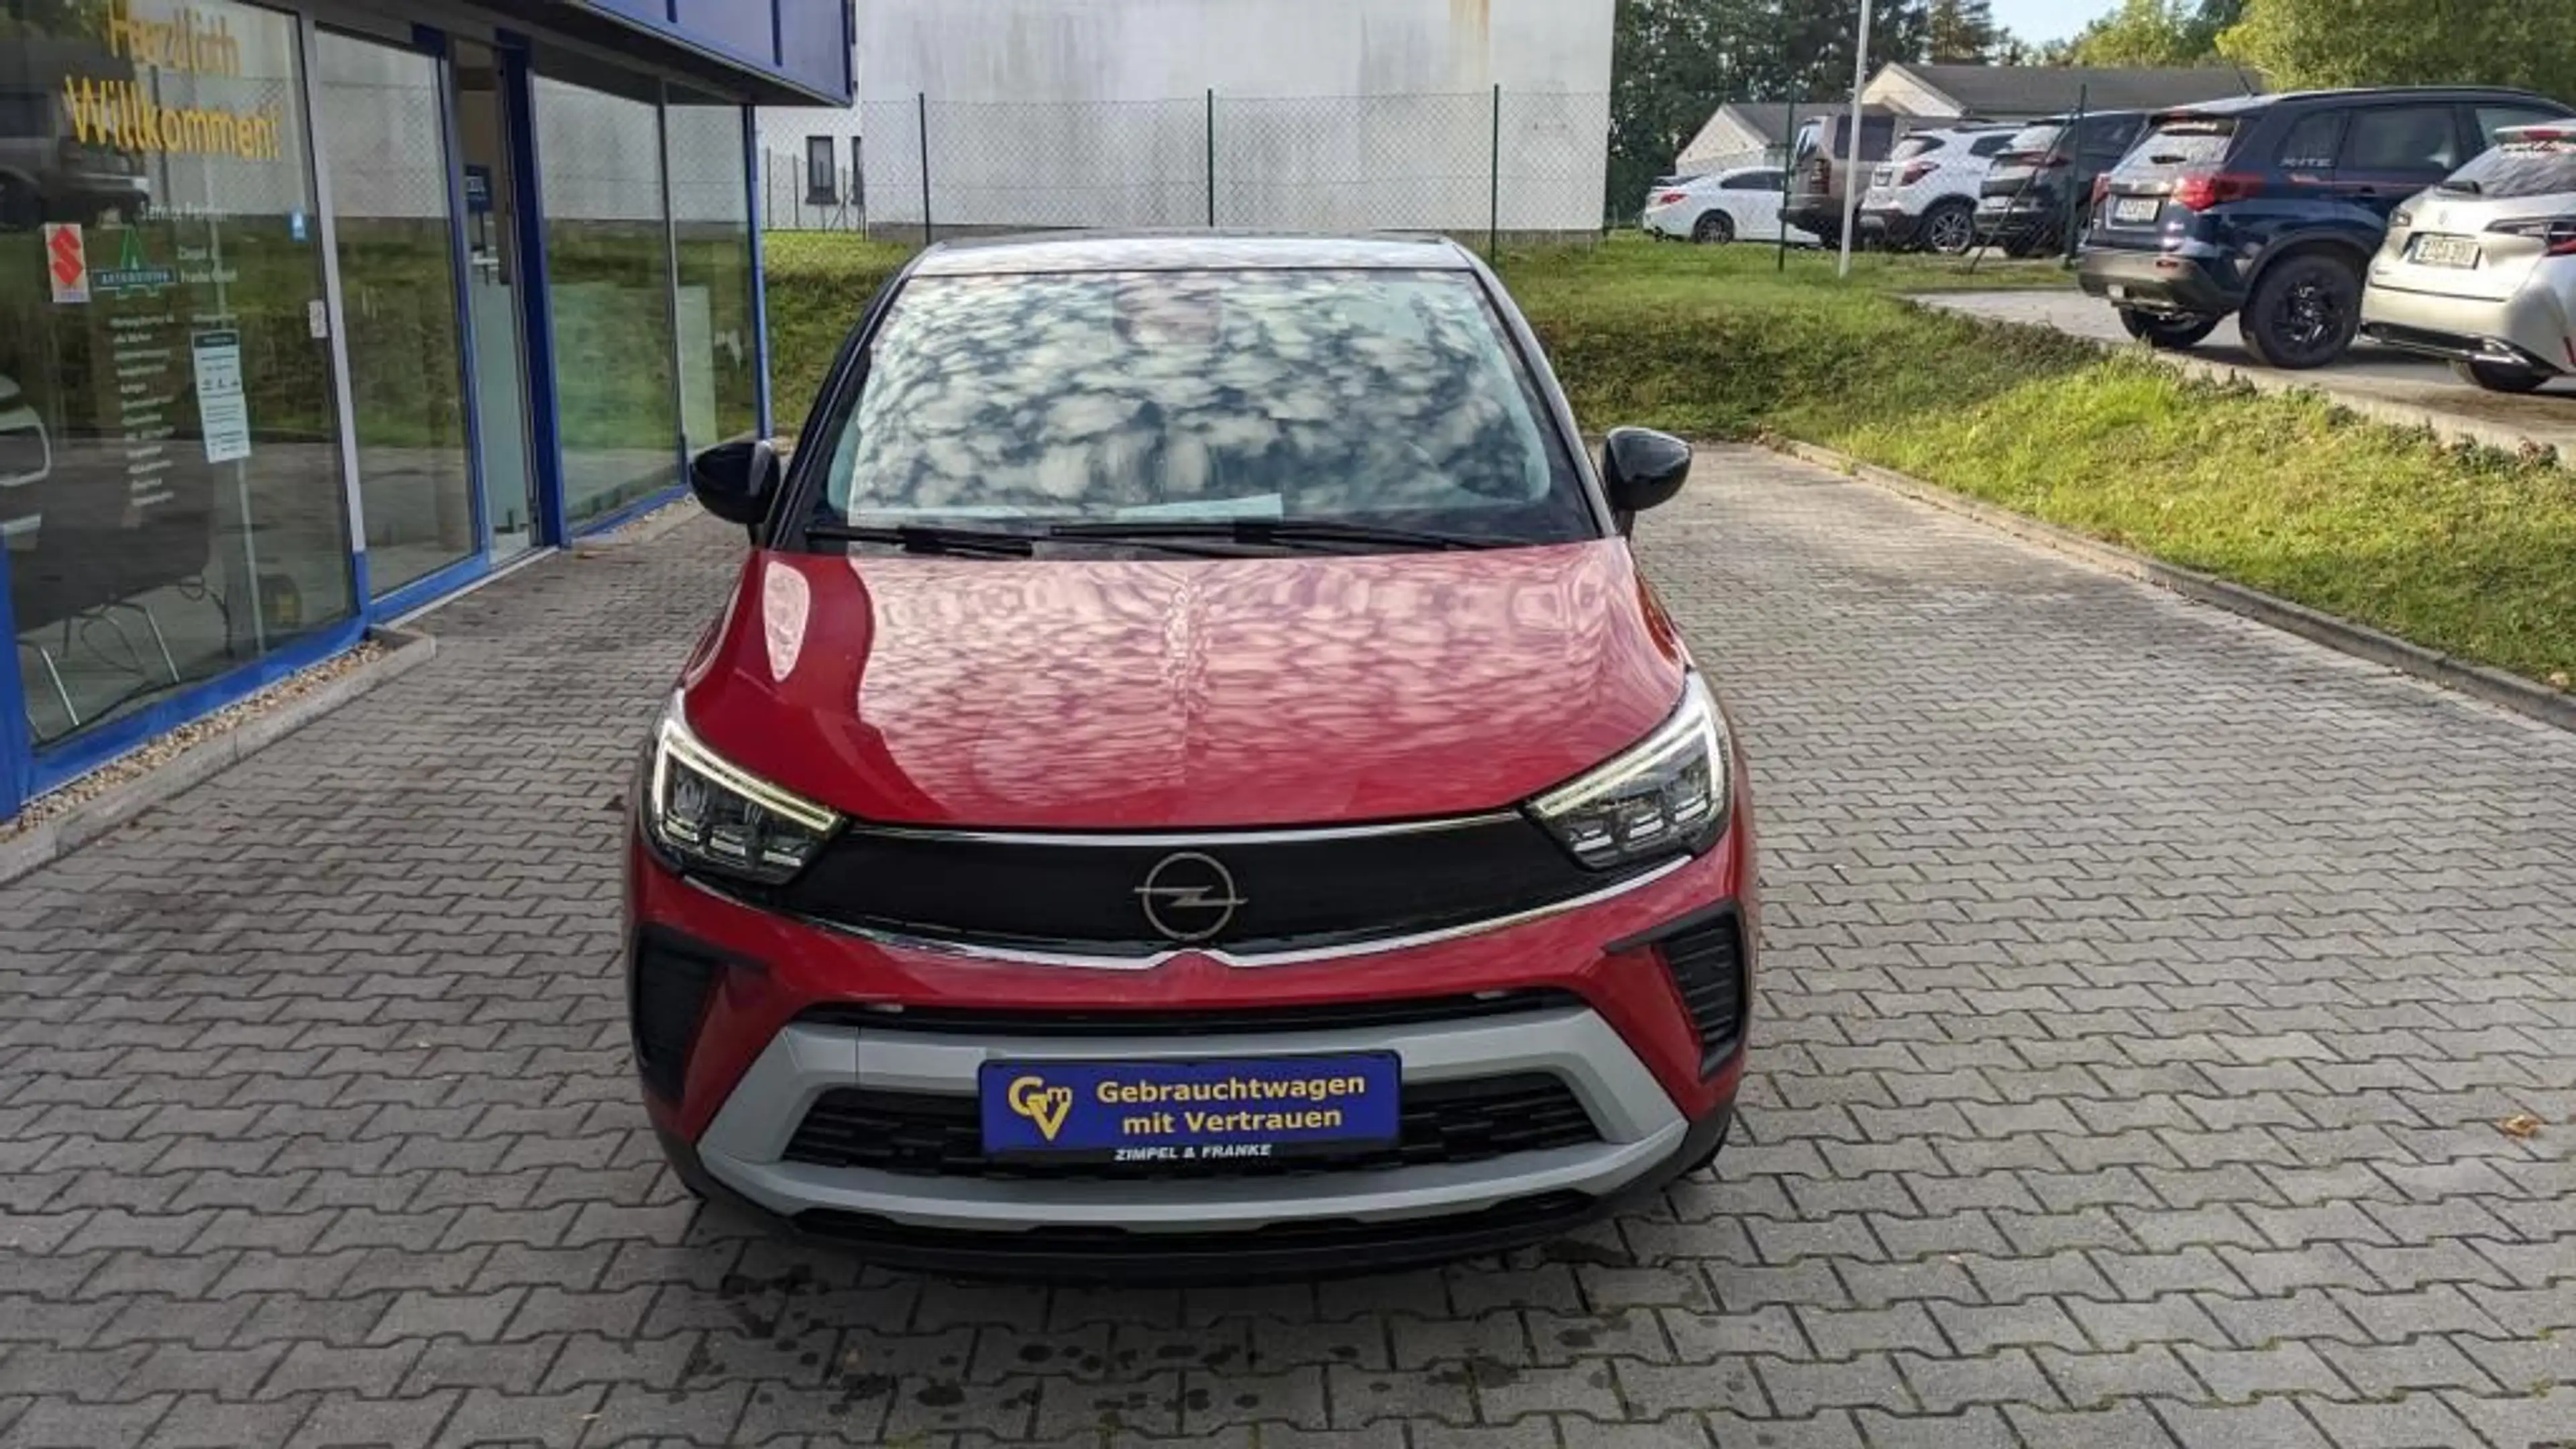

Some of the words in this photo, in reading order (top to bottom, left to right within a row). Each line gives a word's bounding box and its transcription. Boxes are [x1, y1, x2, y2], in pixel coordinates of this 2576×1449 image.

[63, 74, 282, 158] Willkommen!
[1096, 1075, 1366, 1104] Gebrauchtwagen
[1123, 1112, 1175, 1134] mit
[1184, 1109, 1342, 1134] Vertrauen
[1114, 1146, 1179, 1161] ZIMPEL
[1201, 1143, 1273, 1159] FRANKE
